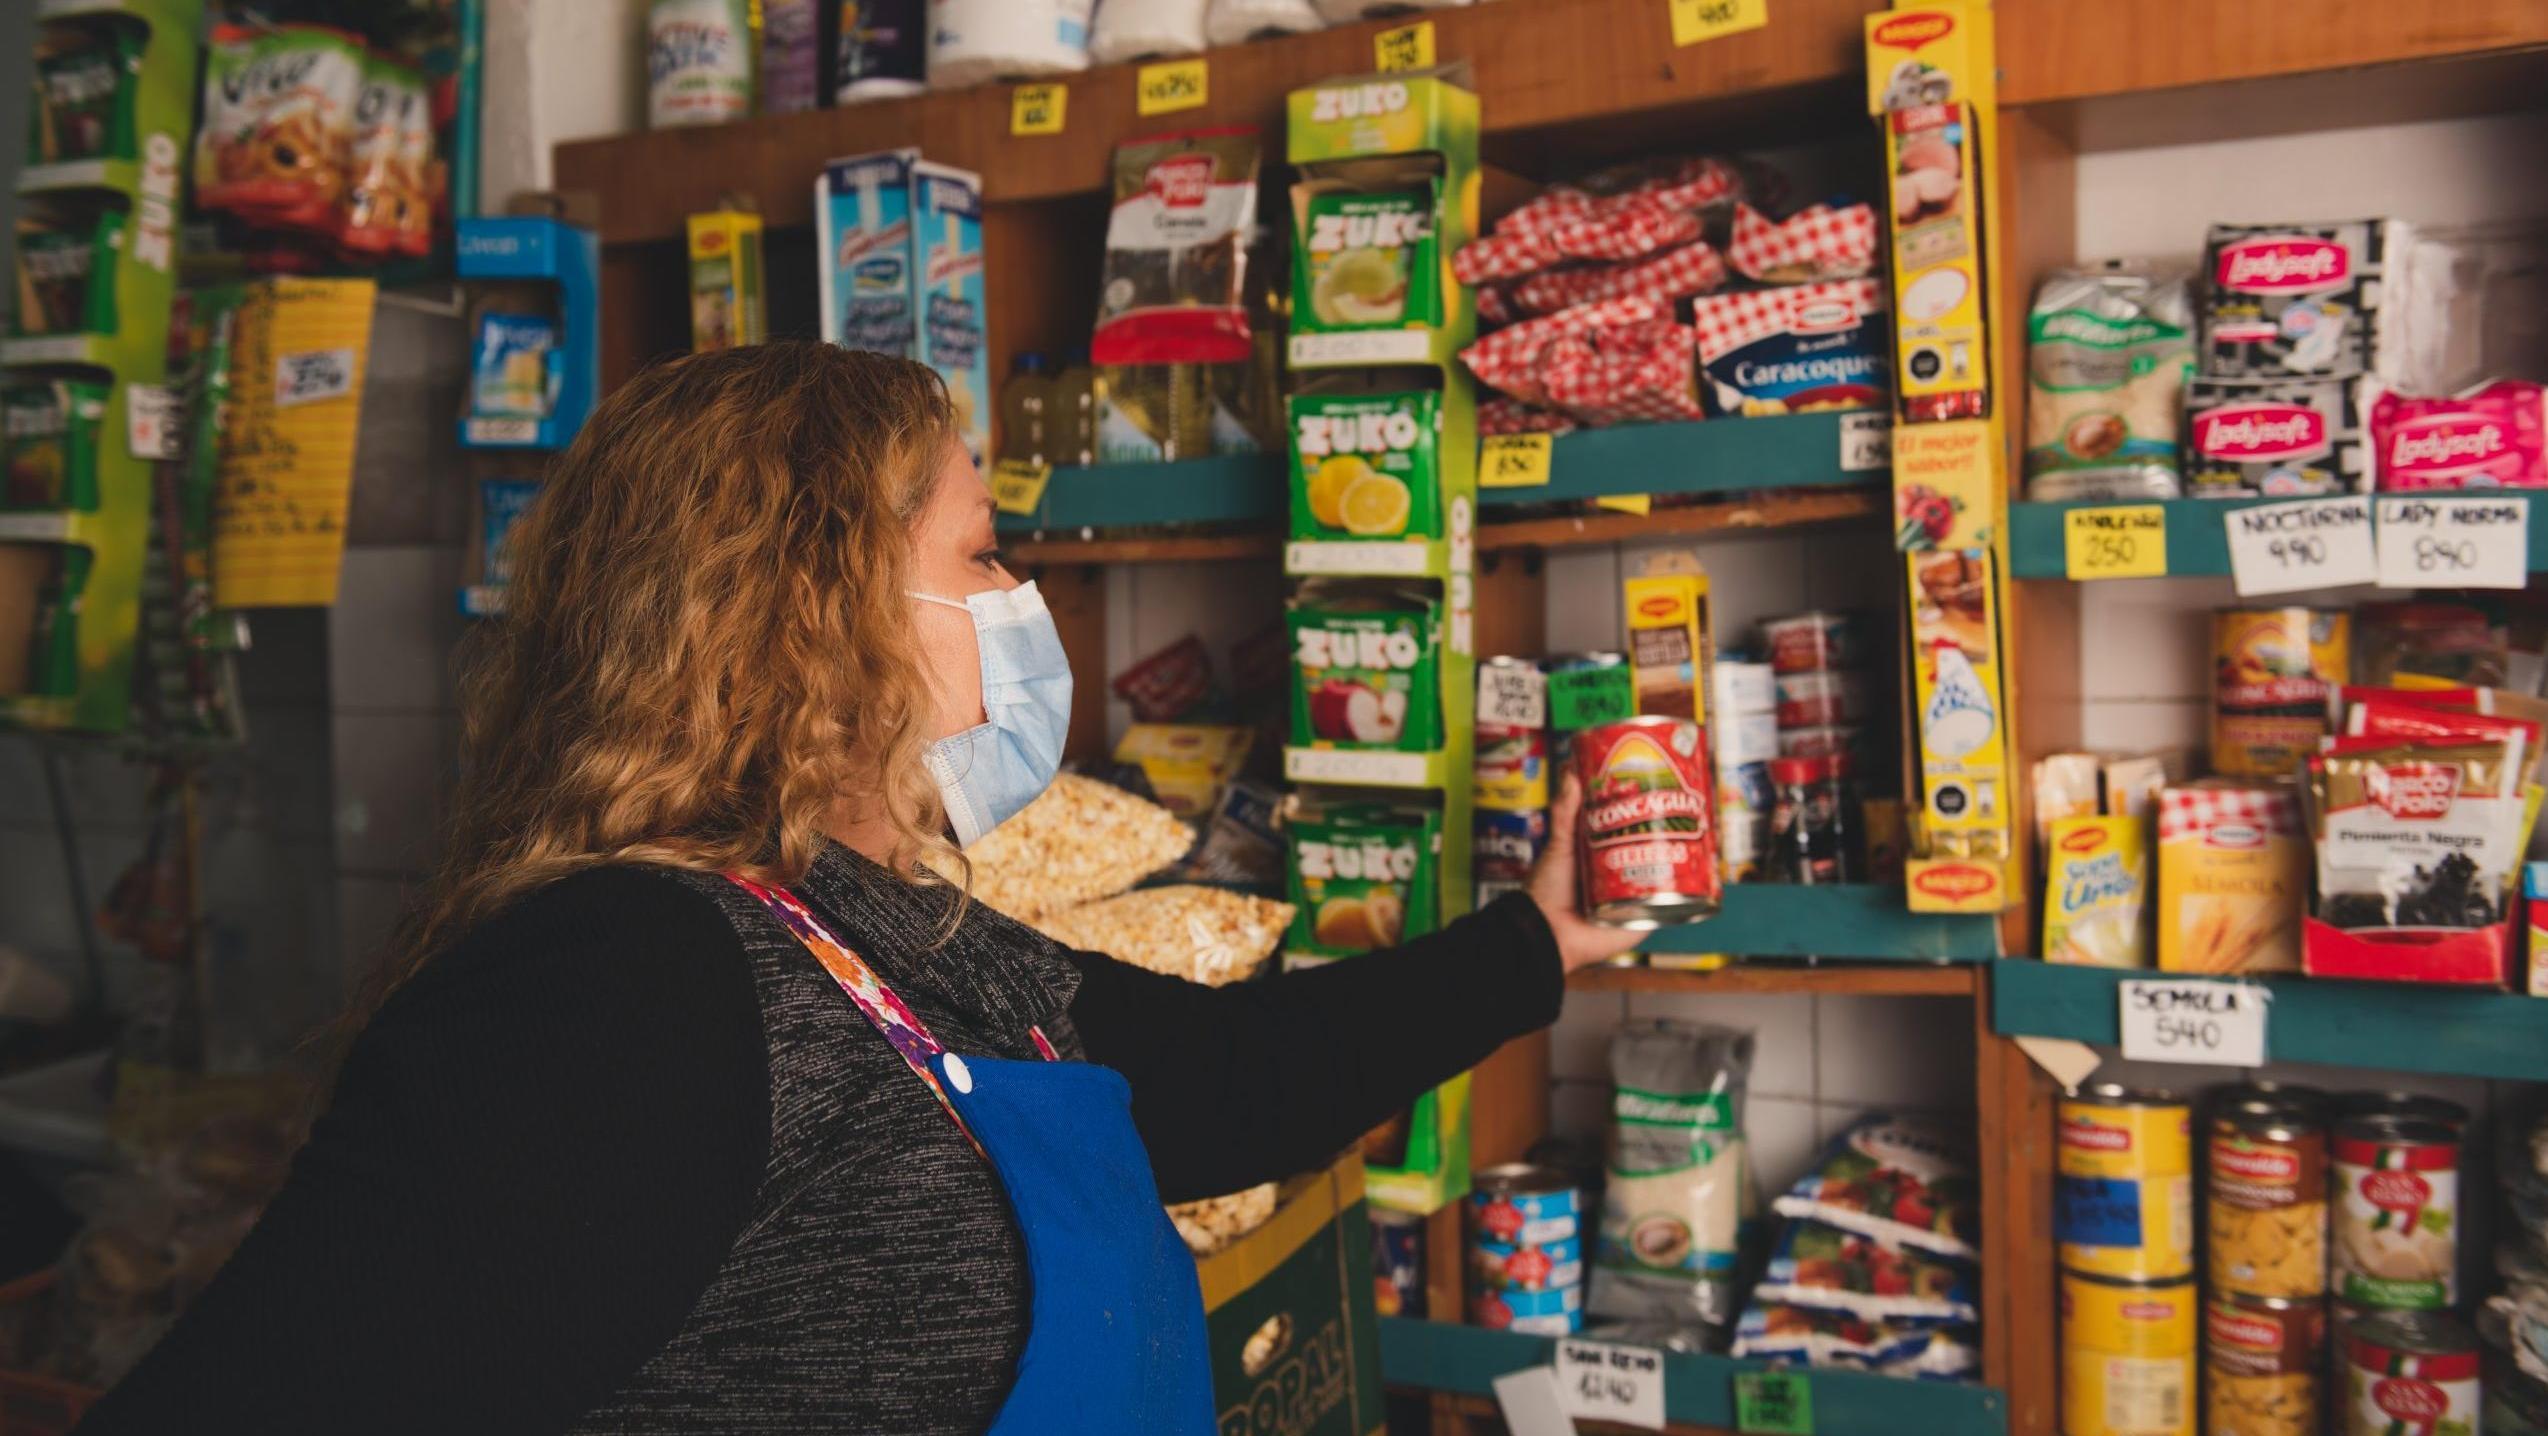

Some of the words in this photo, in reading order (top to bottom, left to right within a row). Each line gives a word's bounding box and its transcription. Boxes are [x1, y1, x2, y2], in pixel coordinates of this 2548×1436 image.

[1311, 82, 1408, 121] ZUKO
[1298, 412, 1418, 456] ZUKO
[1298, 626, 1419, 669] ZUKO
[1297, 838, 1418, 883] ZUKO
